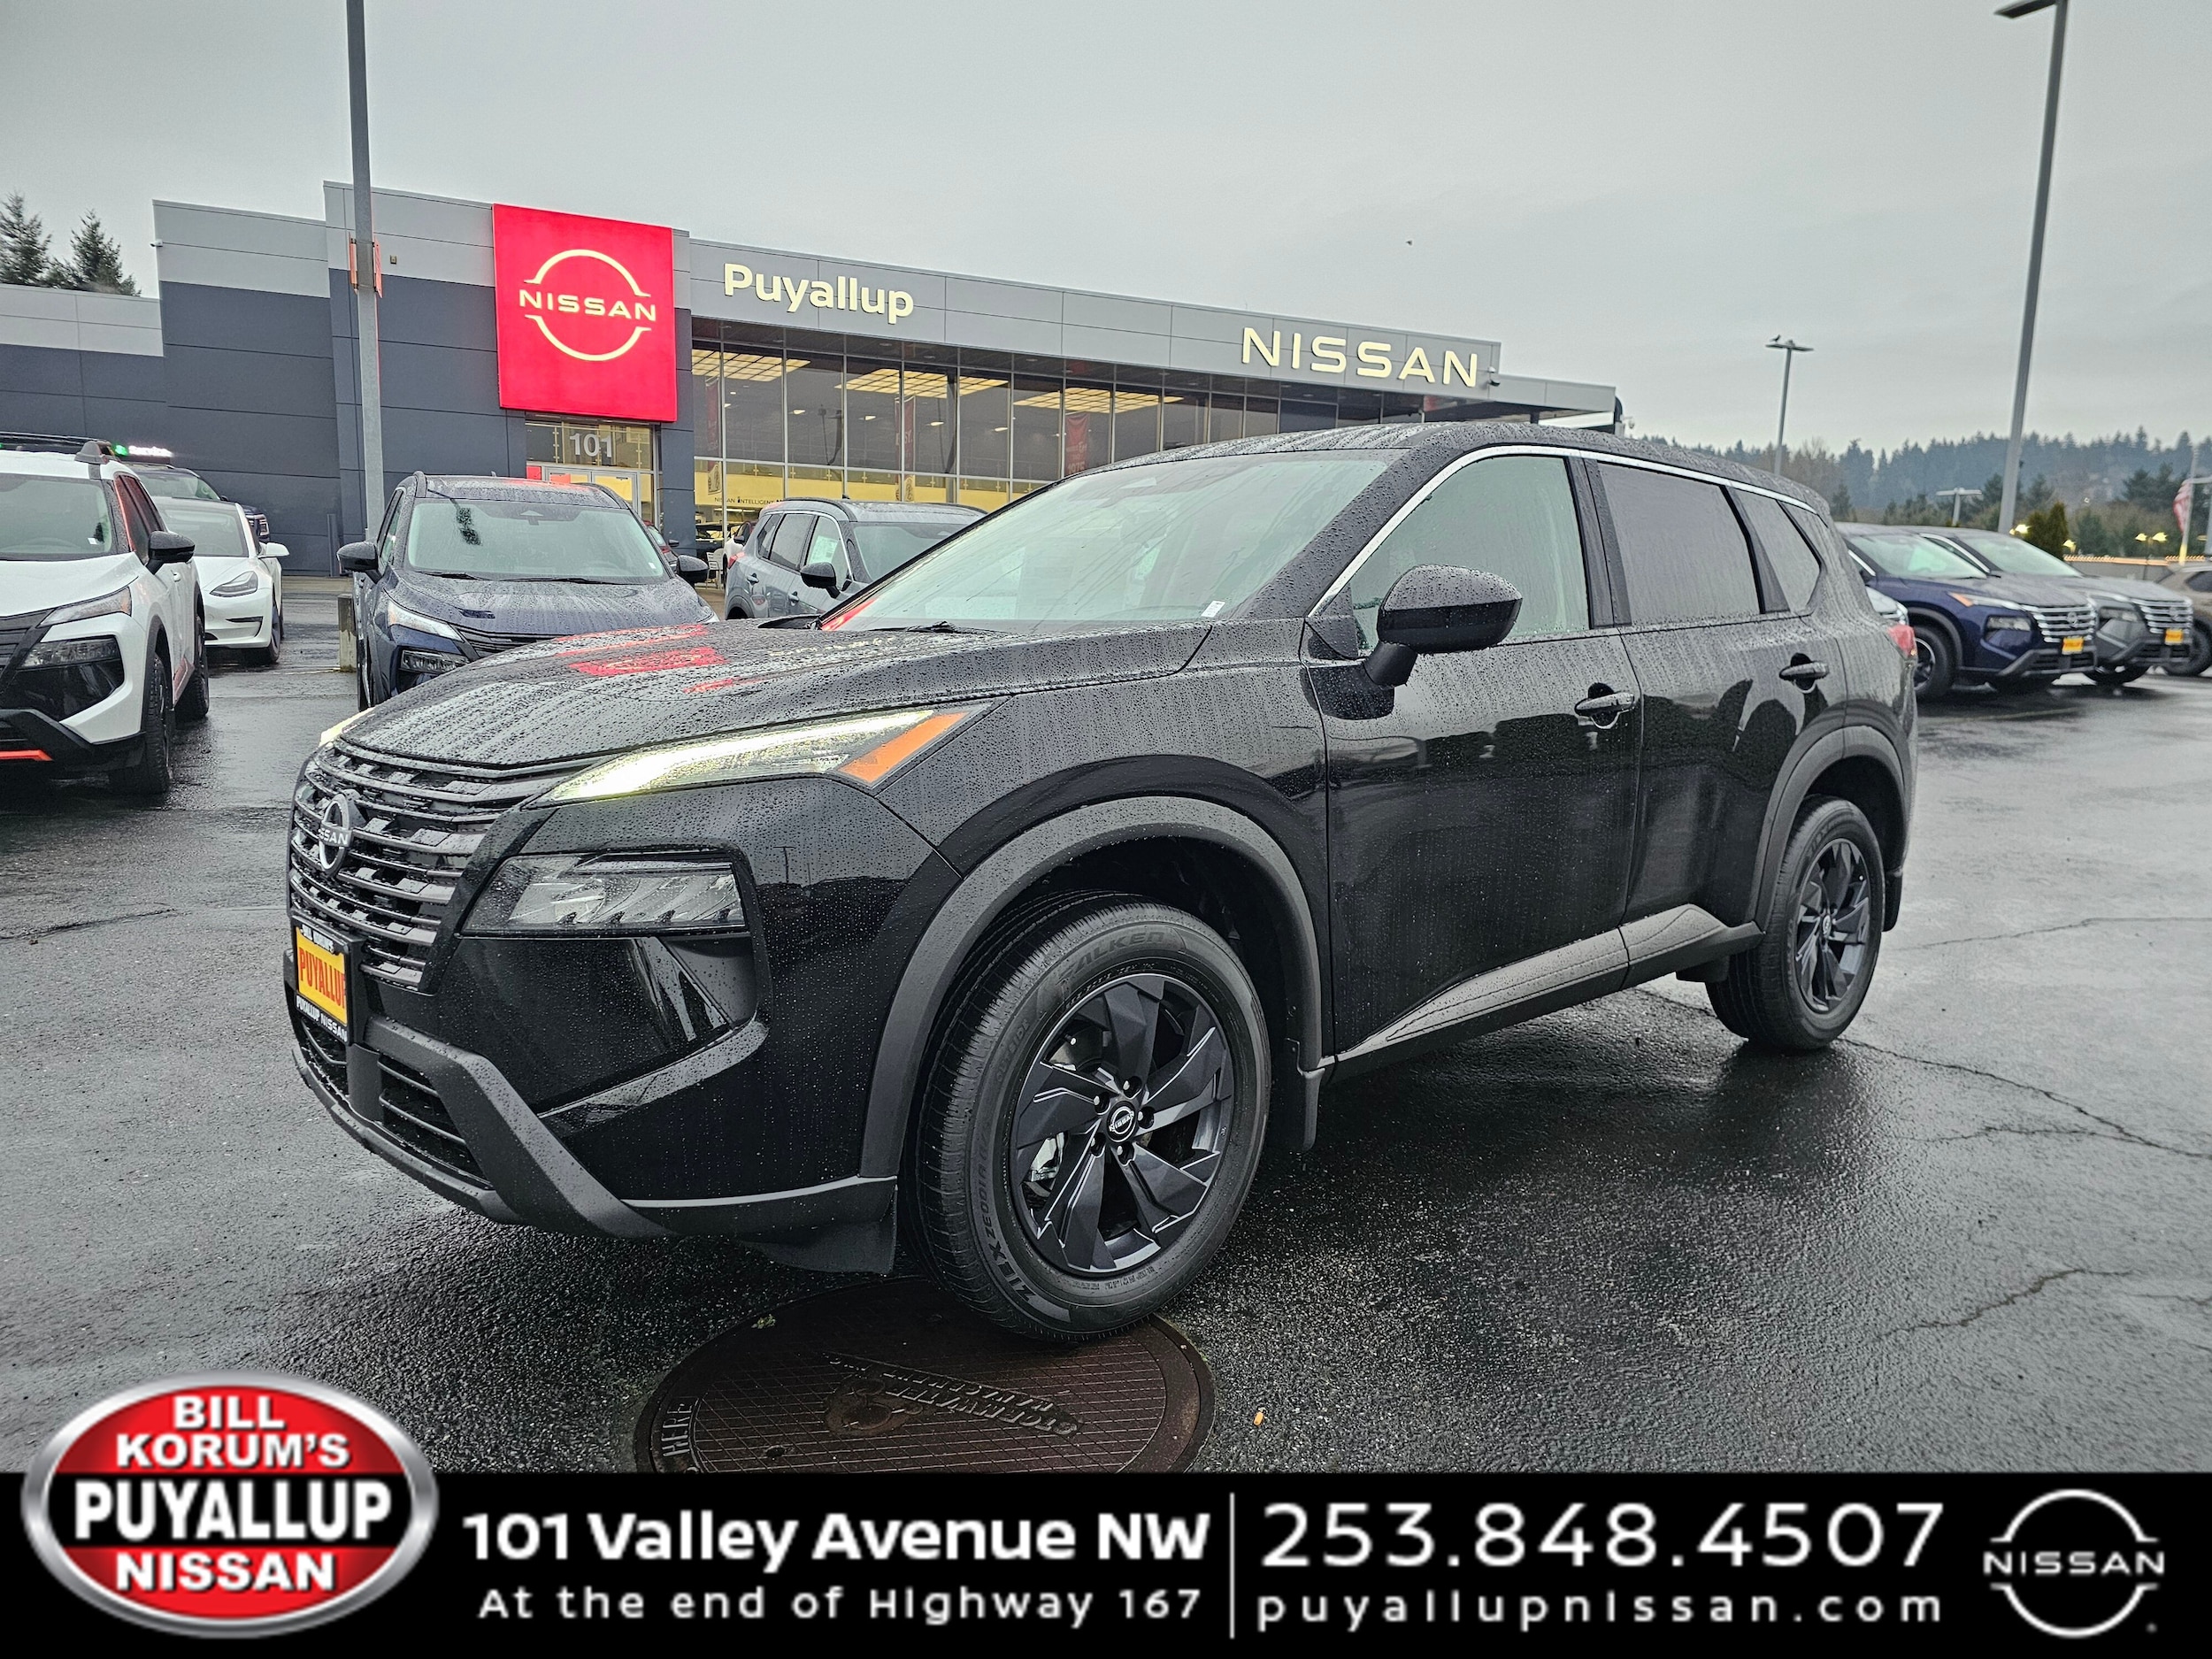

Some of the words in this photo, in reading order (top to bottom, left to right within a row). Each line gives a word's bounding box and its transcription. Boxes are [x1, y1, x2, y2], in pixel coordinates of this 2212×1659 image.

[518, 288, 657, 322] NISSAN
[724, 263, 915, 325] Puyallup
[1241, 326, 1479, 388] NISSAN
[569, 433, 612, 458] 101
[320, 1012, 348, 1043] NISSAN
[988, 1240, 1037, 1302] ZIEX
